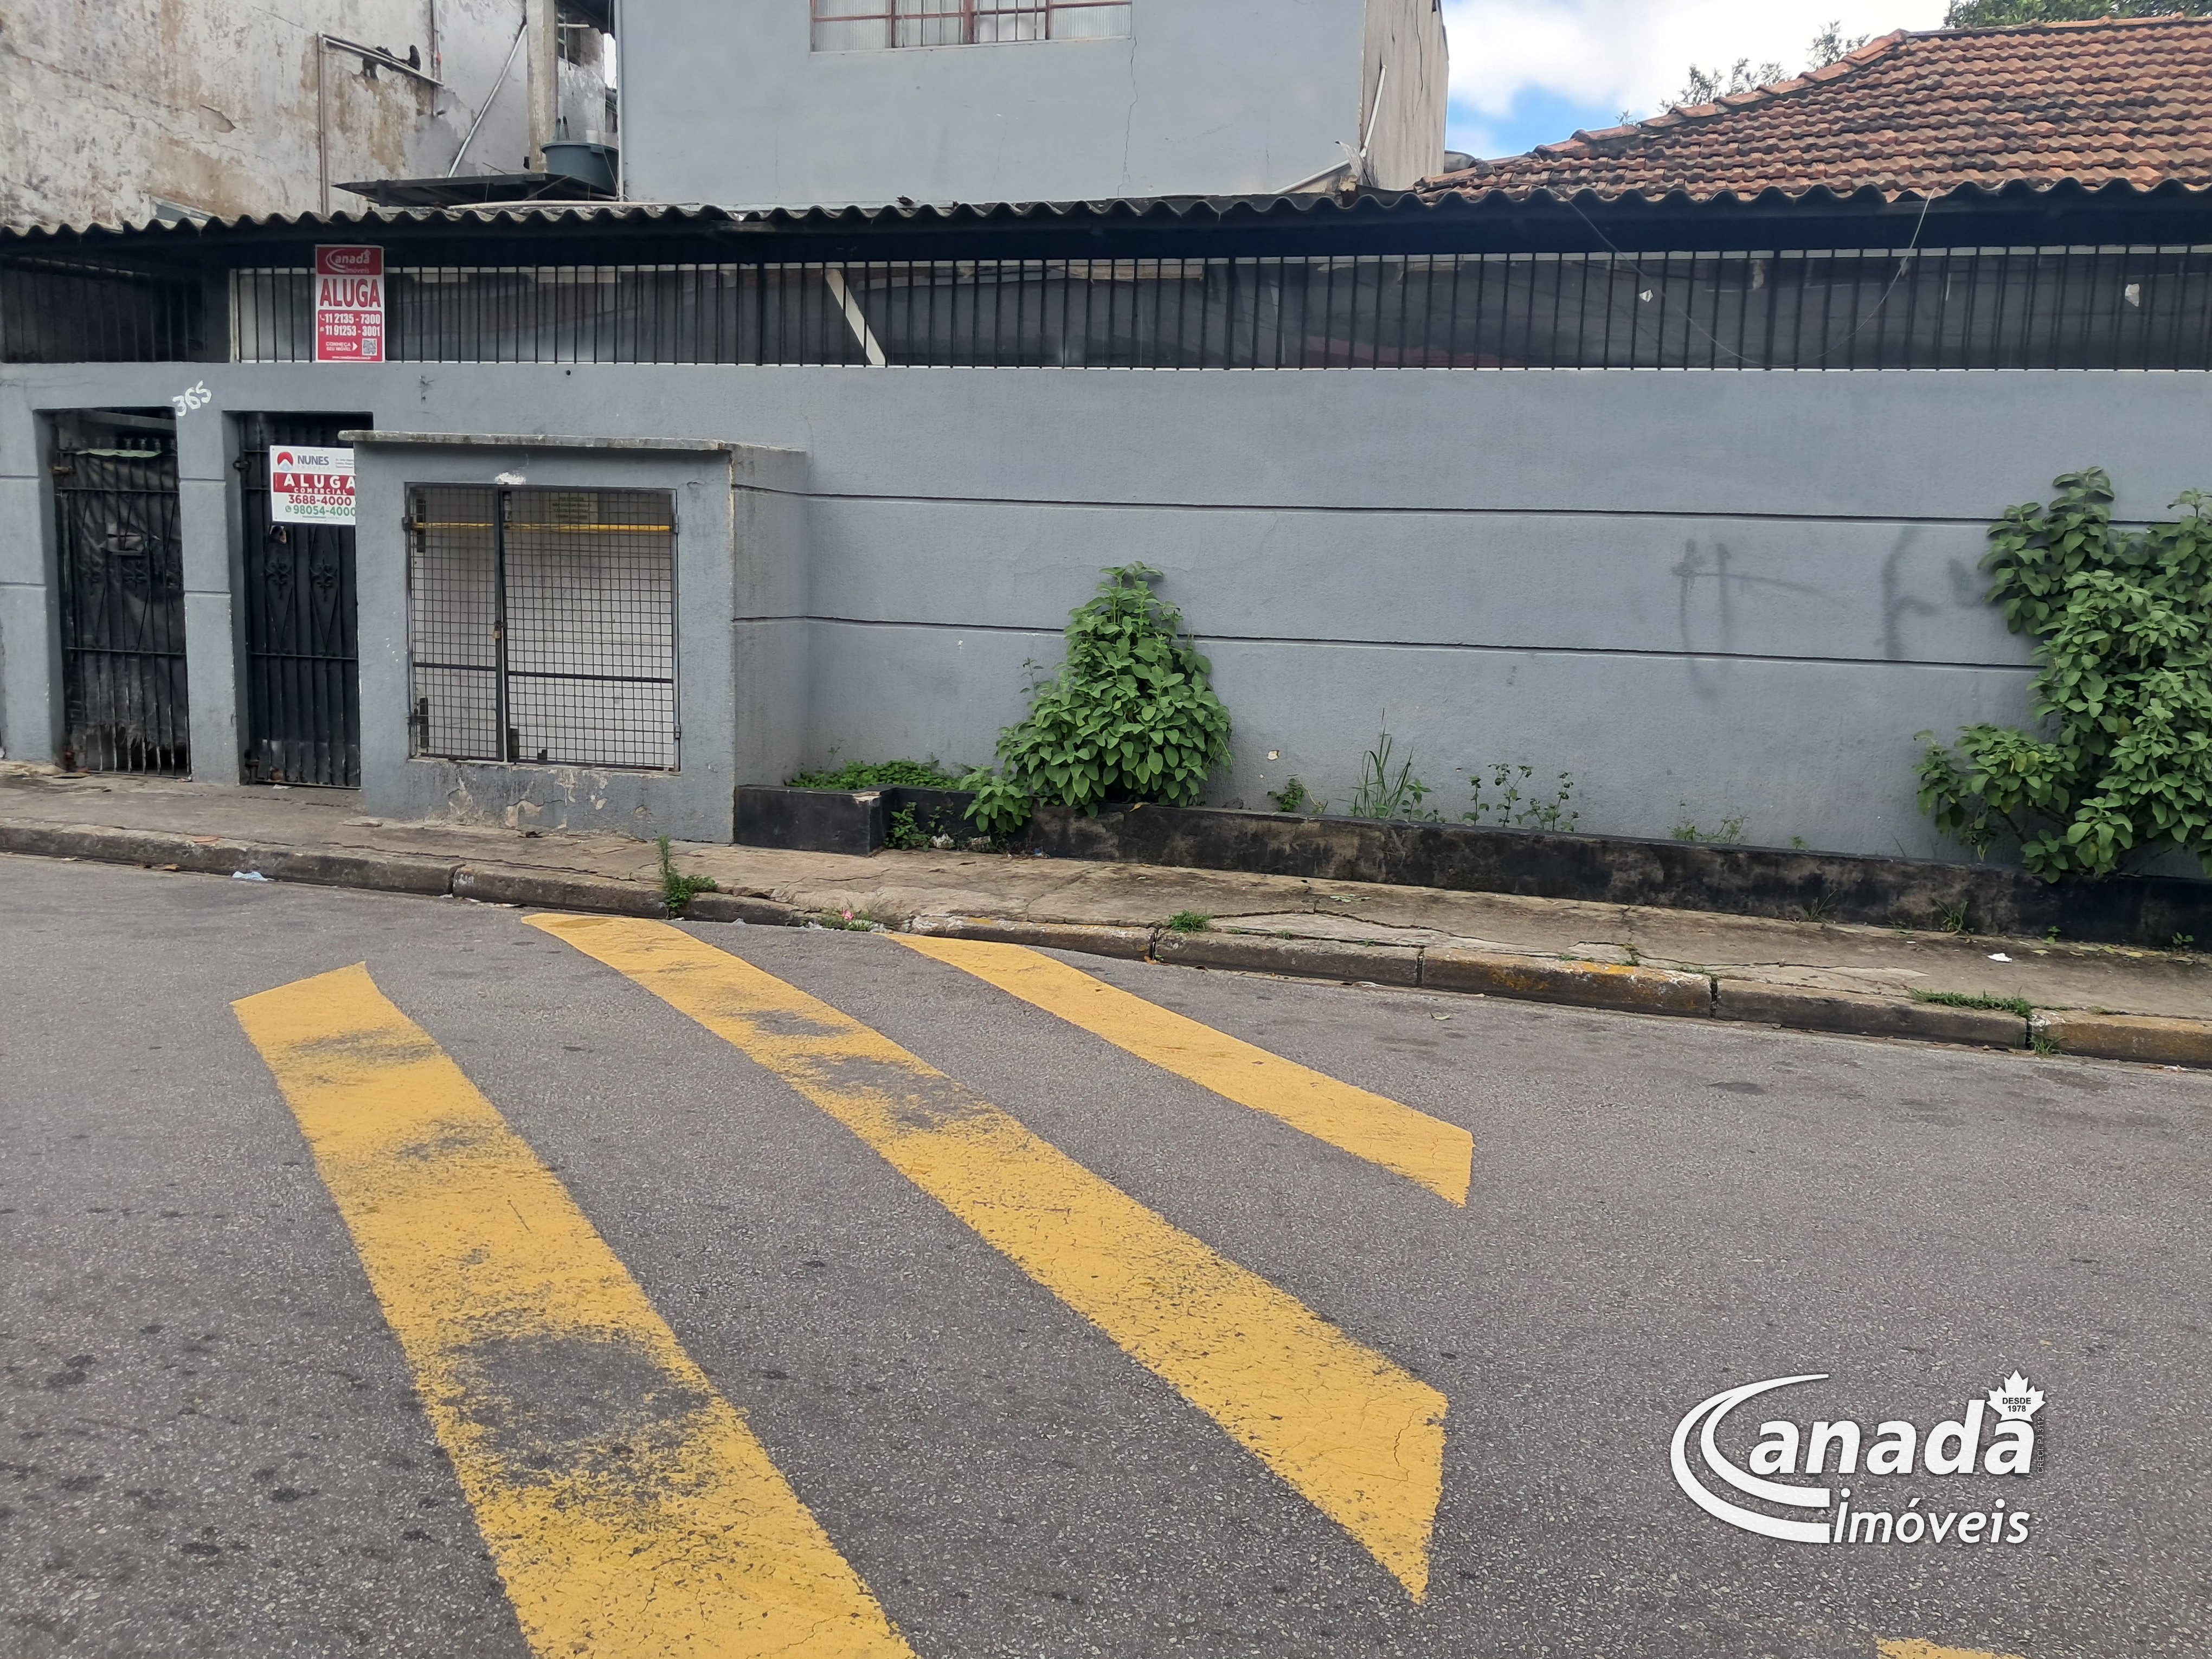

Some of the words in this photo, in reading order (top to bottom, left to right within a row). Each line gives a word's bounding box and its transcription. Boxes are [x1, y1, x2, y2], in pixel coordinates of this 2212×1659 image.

[319, 279, 381, 307] ALUGA
[325, 313, 333, 323] 11
[335, 313, 354, 324] 2135
[361, 314, 381, 324] 7300
[325, 325, 332, 335] 11
[334, 325, 356, 336] 91253
[362, 326, 380, 336] 3001
[172, 380, 212, 417] 365
[297, 455, 330, 466] NUNES
[284, 473, 356, 489] ALUGA
[288, 494, 352, 506] 3688-4000
[293, 505, 356, 517] 98054-4000
